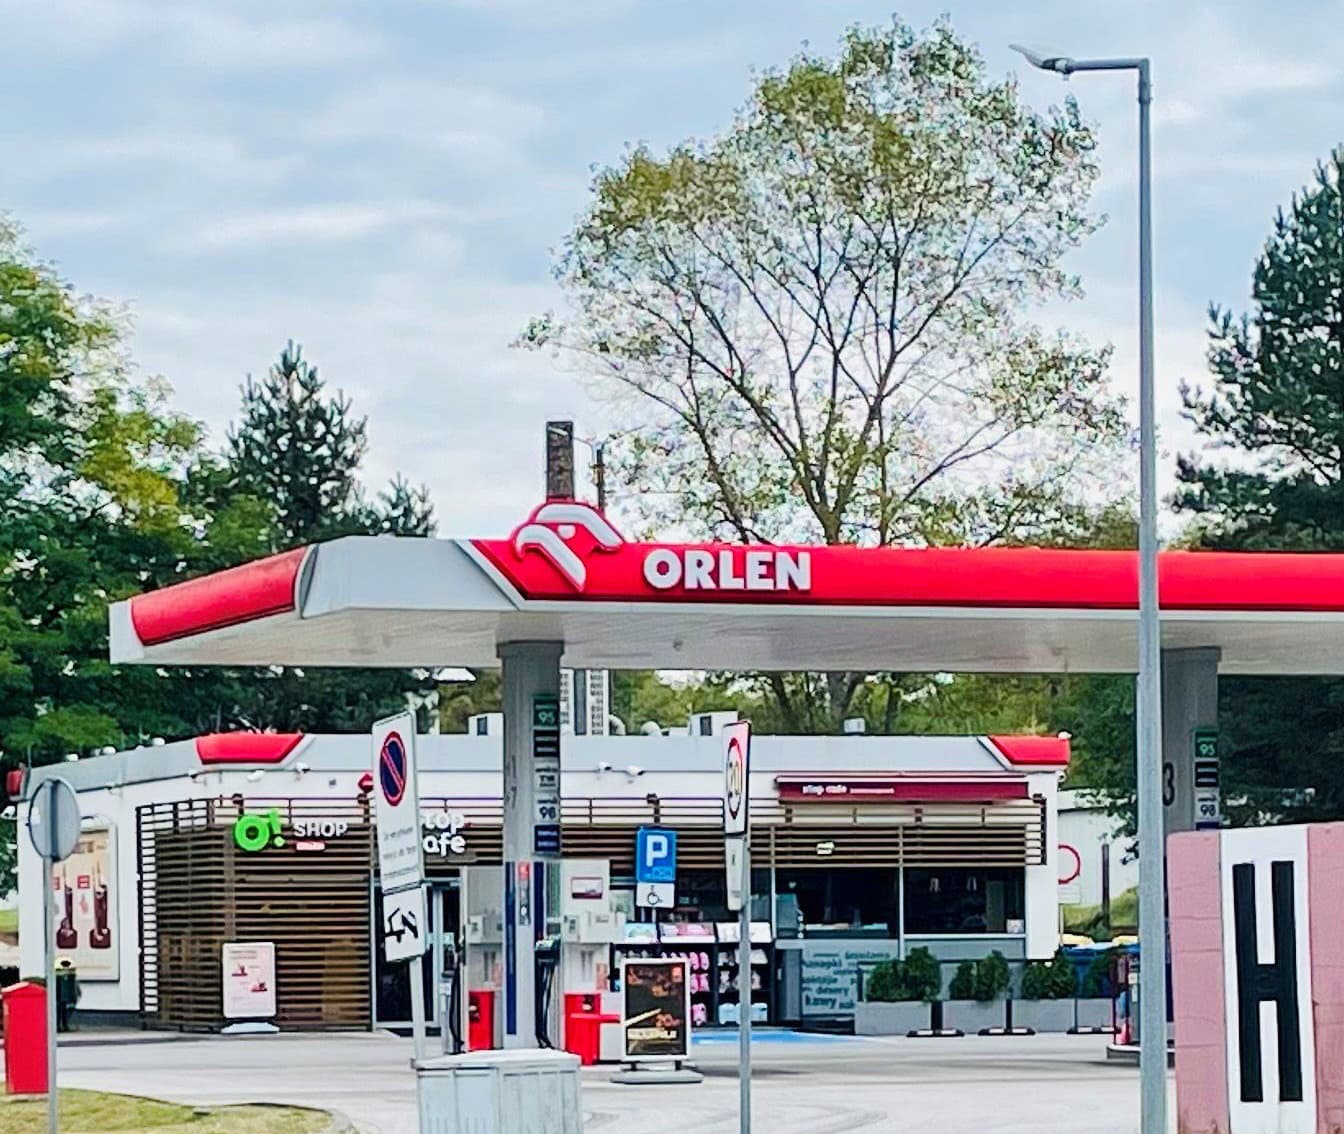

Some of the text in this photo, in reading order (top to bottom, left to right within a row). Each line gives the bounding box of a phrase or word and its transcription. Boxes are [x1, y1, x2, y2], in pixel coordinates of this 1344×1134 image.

[642, 548, 813, 592] ORLEN
[293, 821, 348, 838] SHOP
[646, 834, 668, 867] P
[1232, 860, 1303, 1102] H
